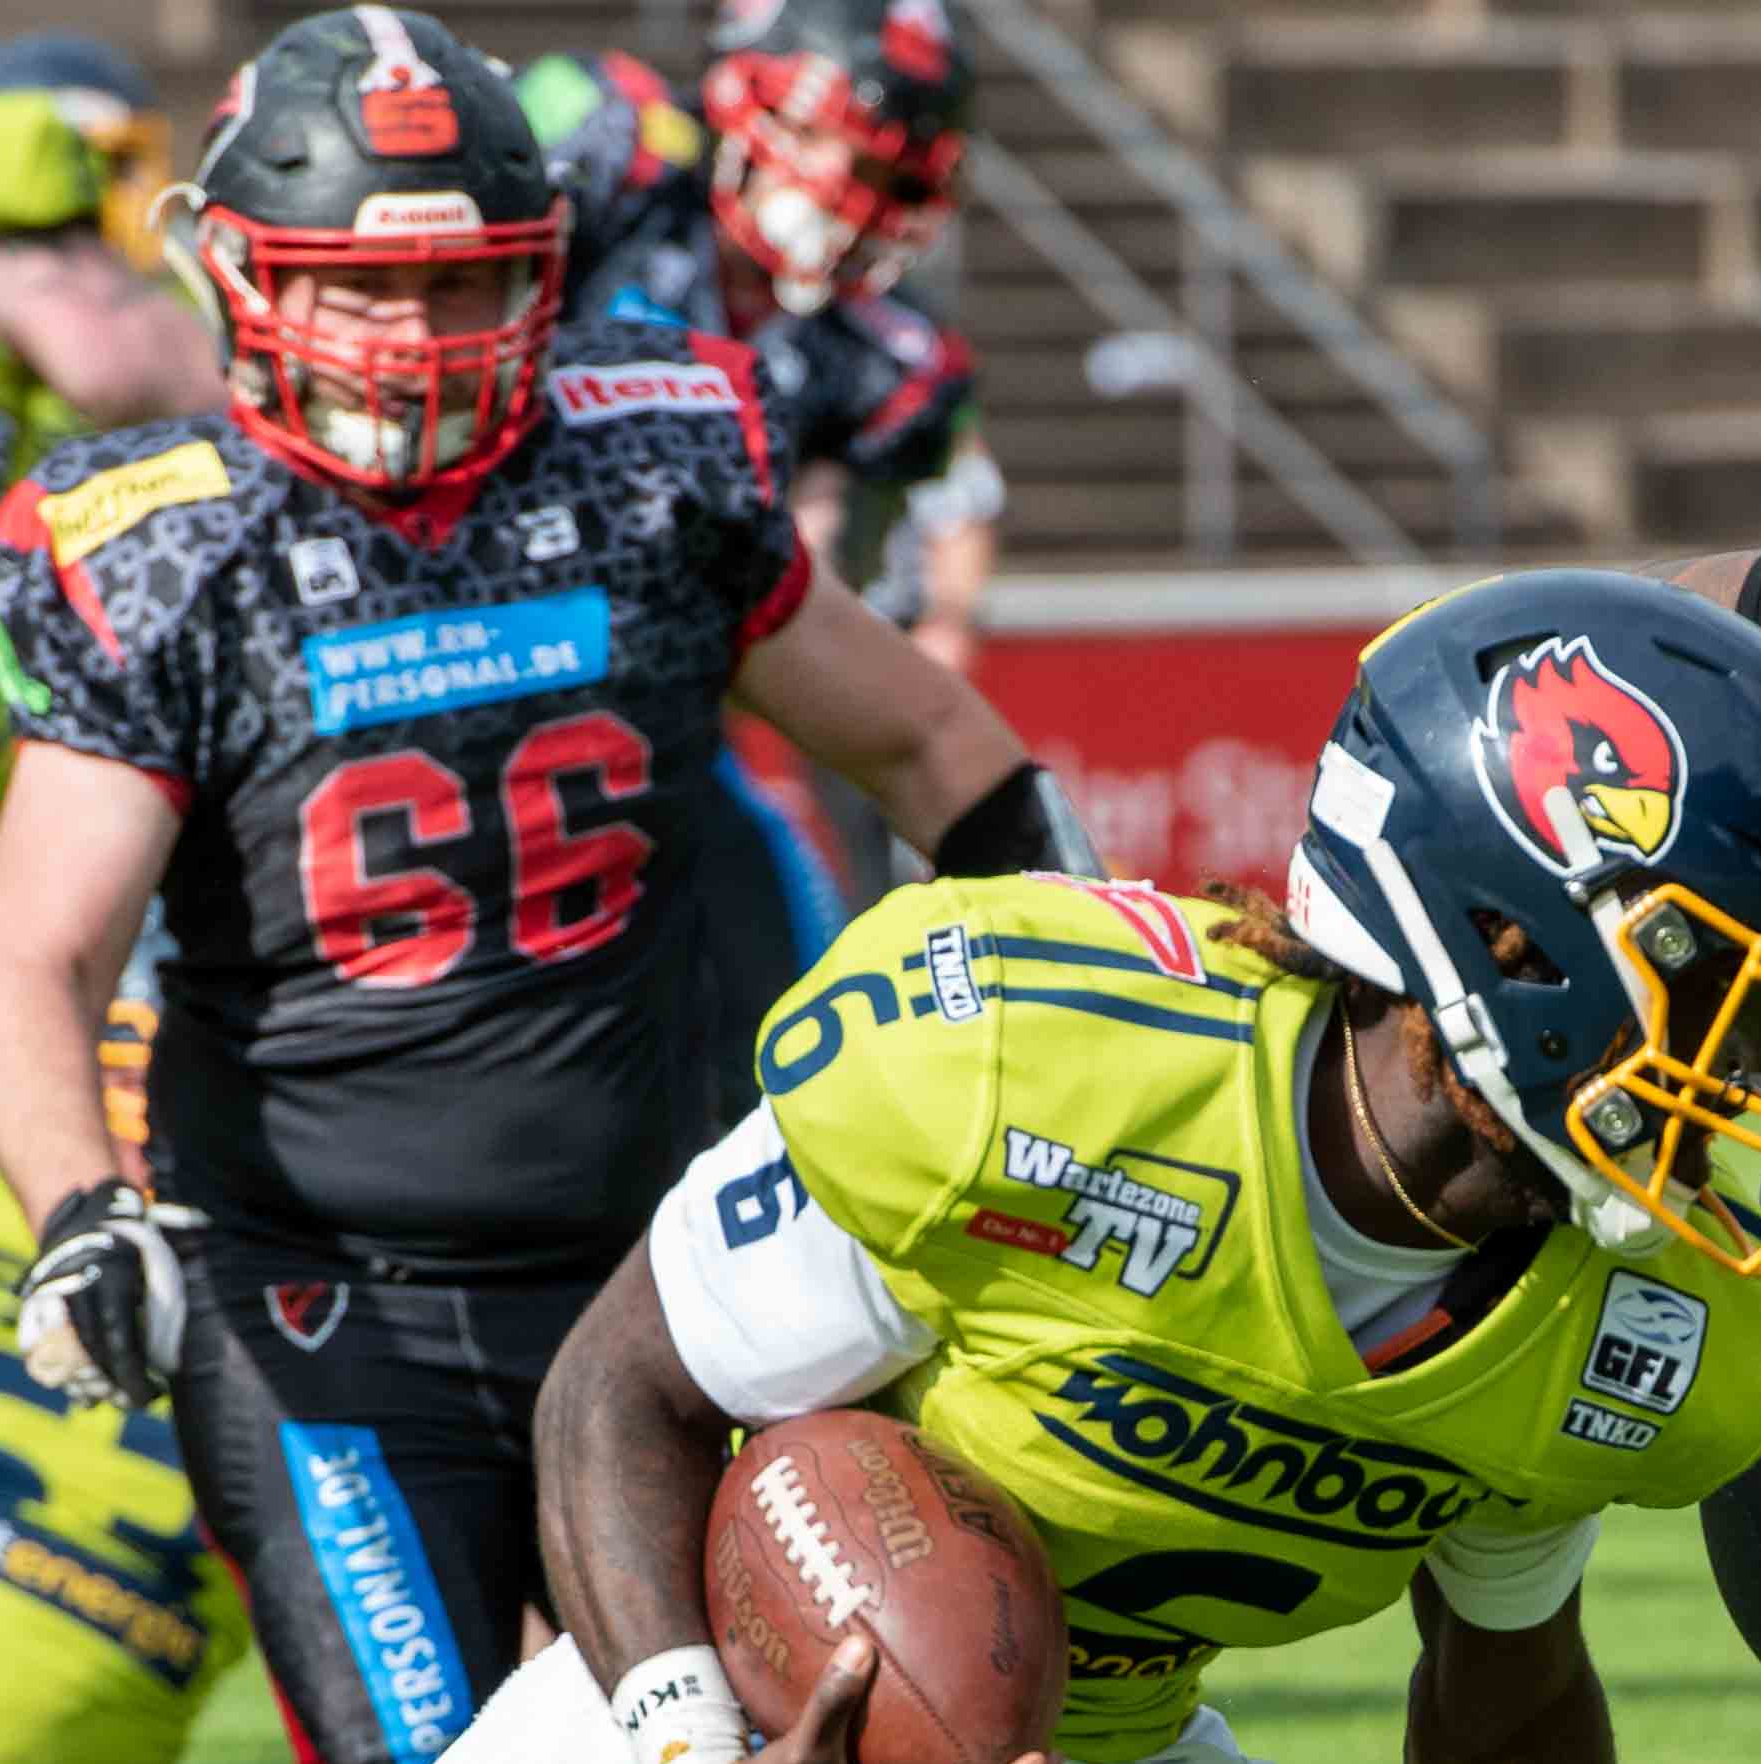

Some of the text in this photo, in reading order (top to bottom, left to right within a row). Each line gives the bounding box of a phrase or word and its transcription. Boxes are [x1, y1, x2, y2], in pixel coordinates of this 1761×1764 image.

[299, 709, 652, 989] 66
[931, 930, 981, 1020] TNKD
[759, 972, 901, 1097] 6
[1005, 1126, 1202, 1226] Wartezone
[1059, 1193, 1200, 1299] TV
[1593, 1332, 1681, 1402] GFL
[1567, 1402, 1659, 1448] TNKD
[308, 1448, 453, 1754] PERSONAL.DE
